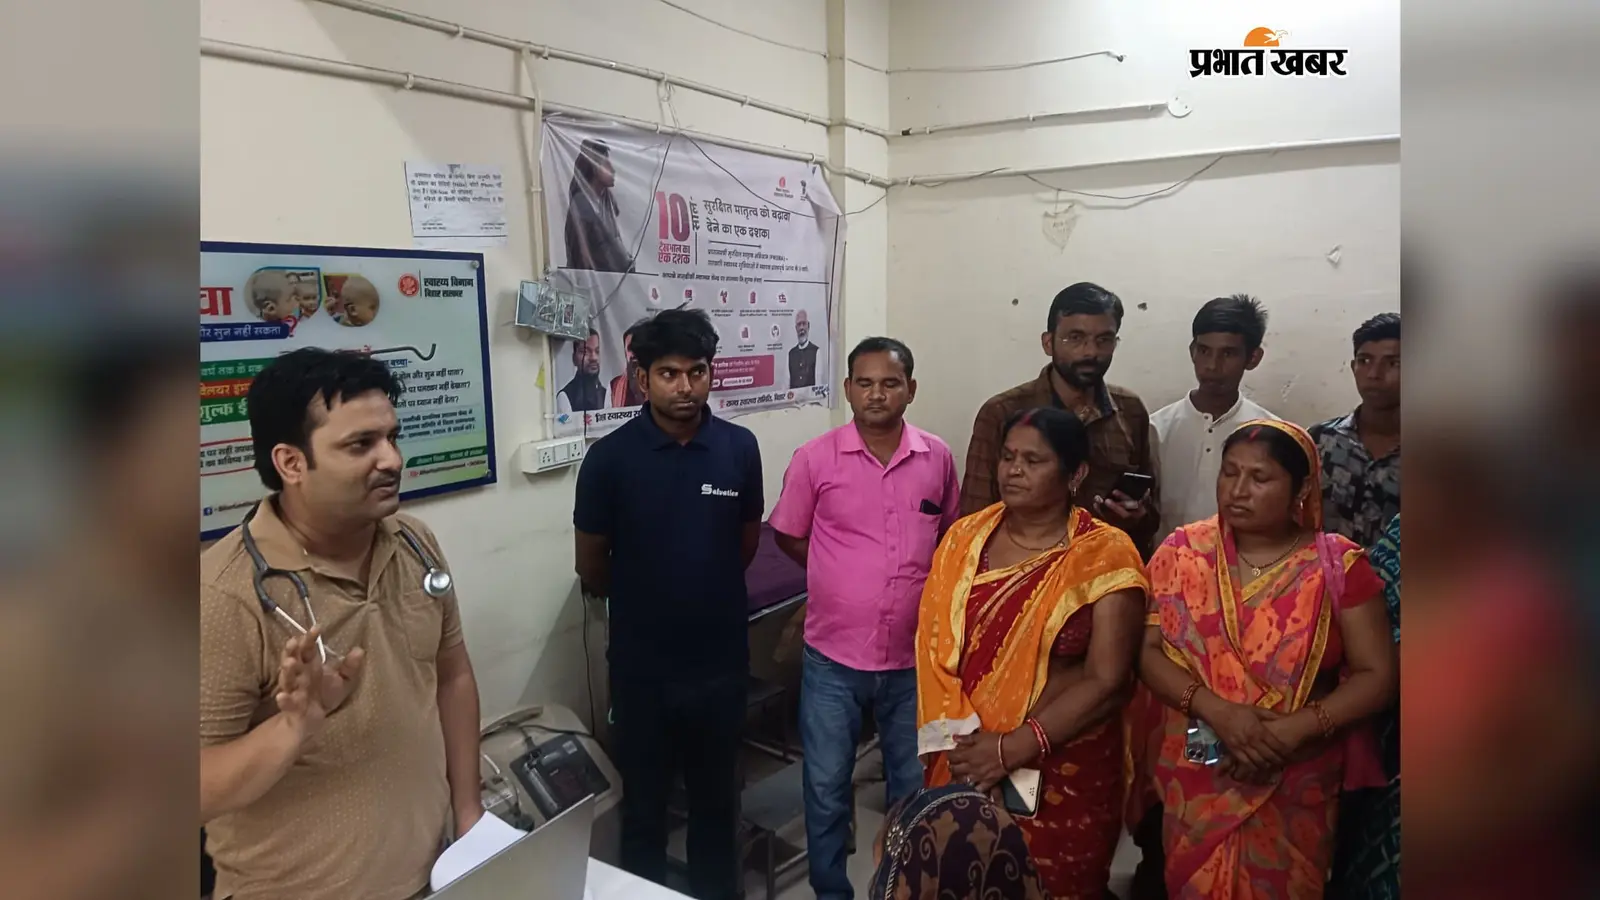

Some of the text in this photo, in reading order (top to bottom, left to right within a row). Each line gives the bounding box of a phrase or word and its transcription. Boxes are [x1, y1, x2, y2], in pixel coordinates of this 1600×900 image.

[703, 197, 733, 215] सुरक्षित
[760, 205, 771, 218] को
[656, 191, 690, 242] 10
[706, 217, 720, 233] देने
[721, 223, 733, 234] का
[734, 225, 748, 237] एक
[658, 252, 671, 264] एक
[451, 276, 474, 287] विभाग
[425, 288, 441, 298] बिहार
[607, 411, 632, 421] स्वास्थ्य
